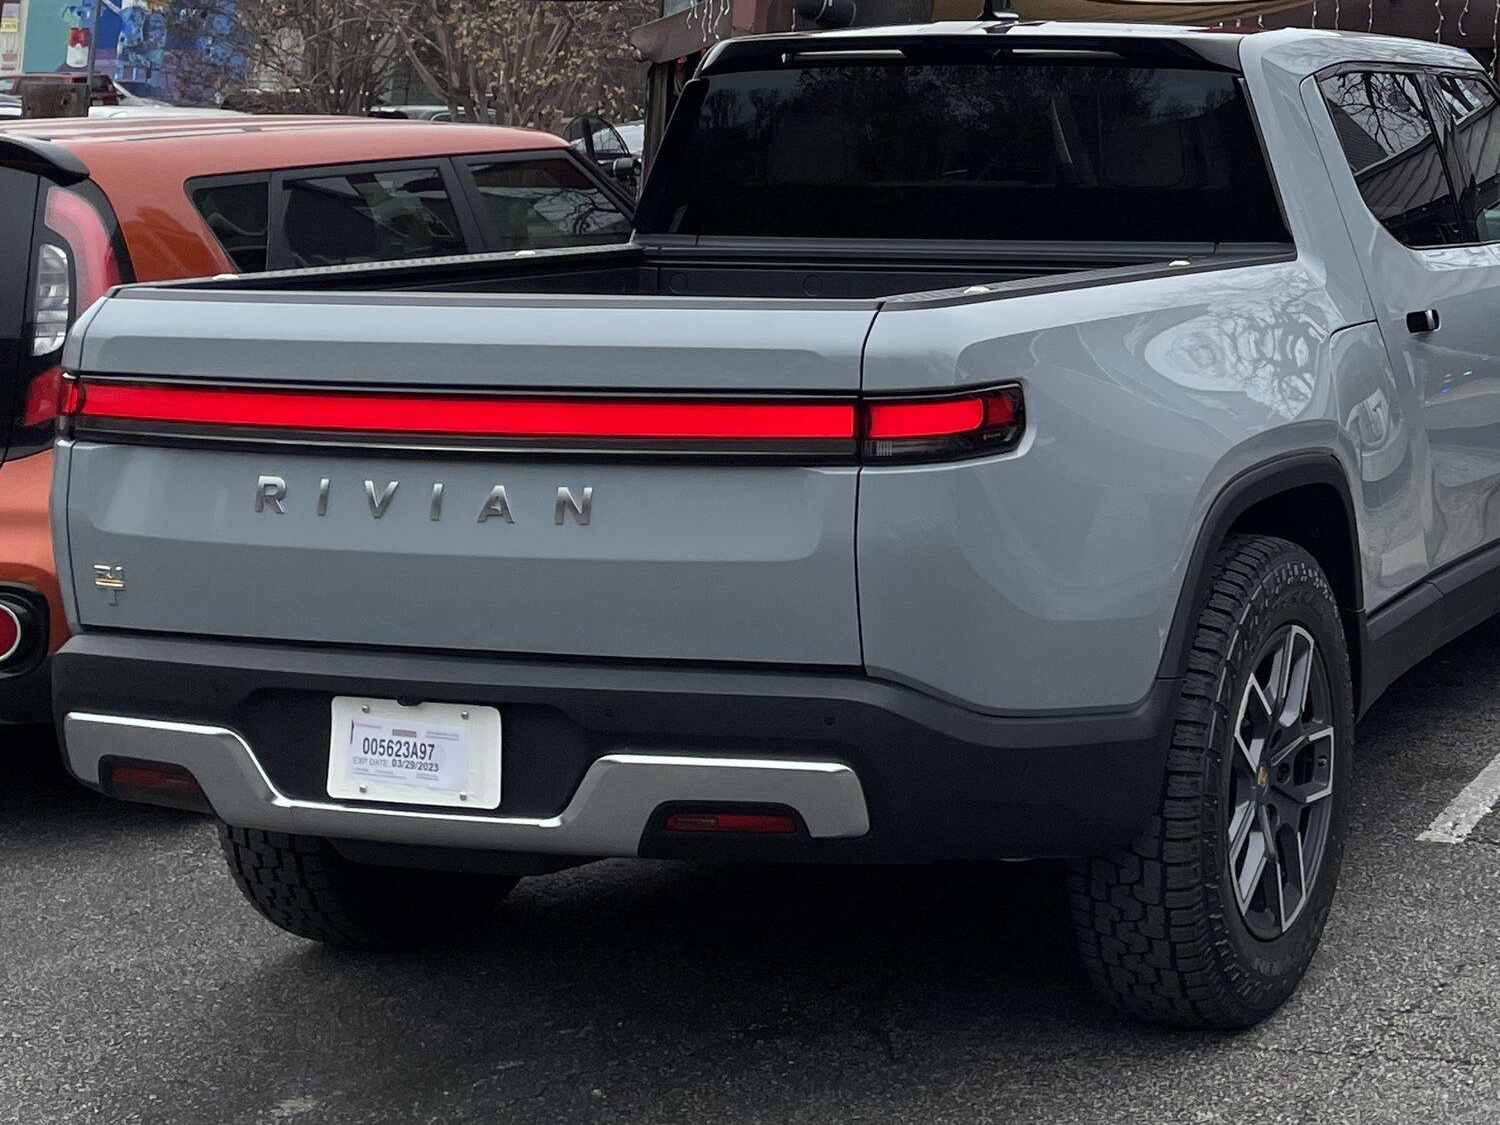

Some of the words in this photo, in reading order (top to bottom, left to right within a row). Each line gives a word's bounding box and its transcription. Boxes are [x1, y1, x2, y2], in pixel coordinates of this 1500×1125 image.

[255, 474, 596, 526] RIVIAN
[362, 737, 435, 761] 005623A97
[391, 759, 439, 772] 03/29/2023
